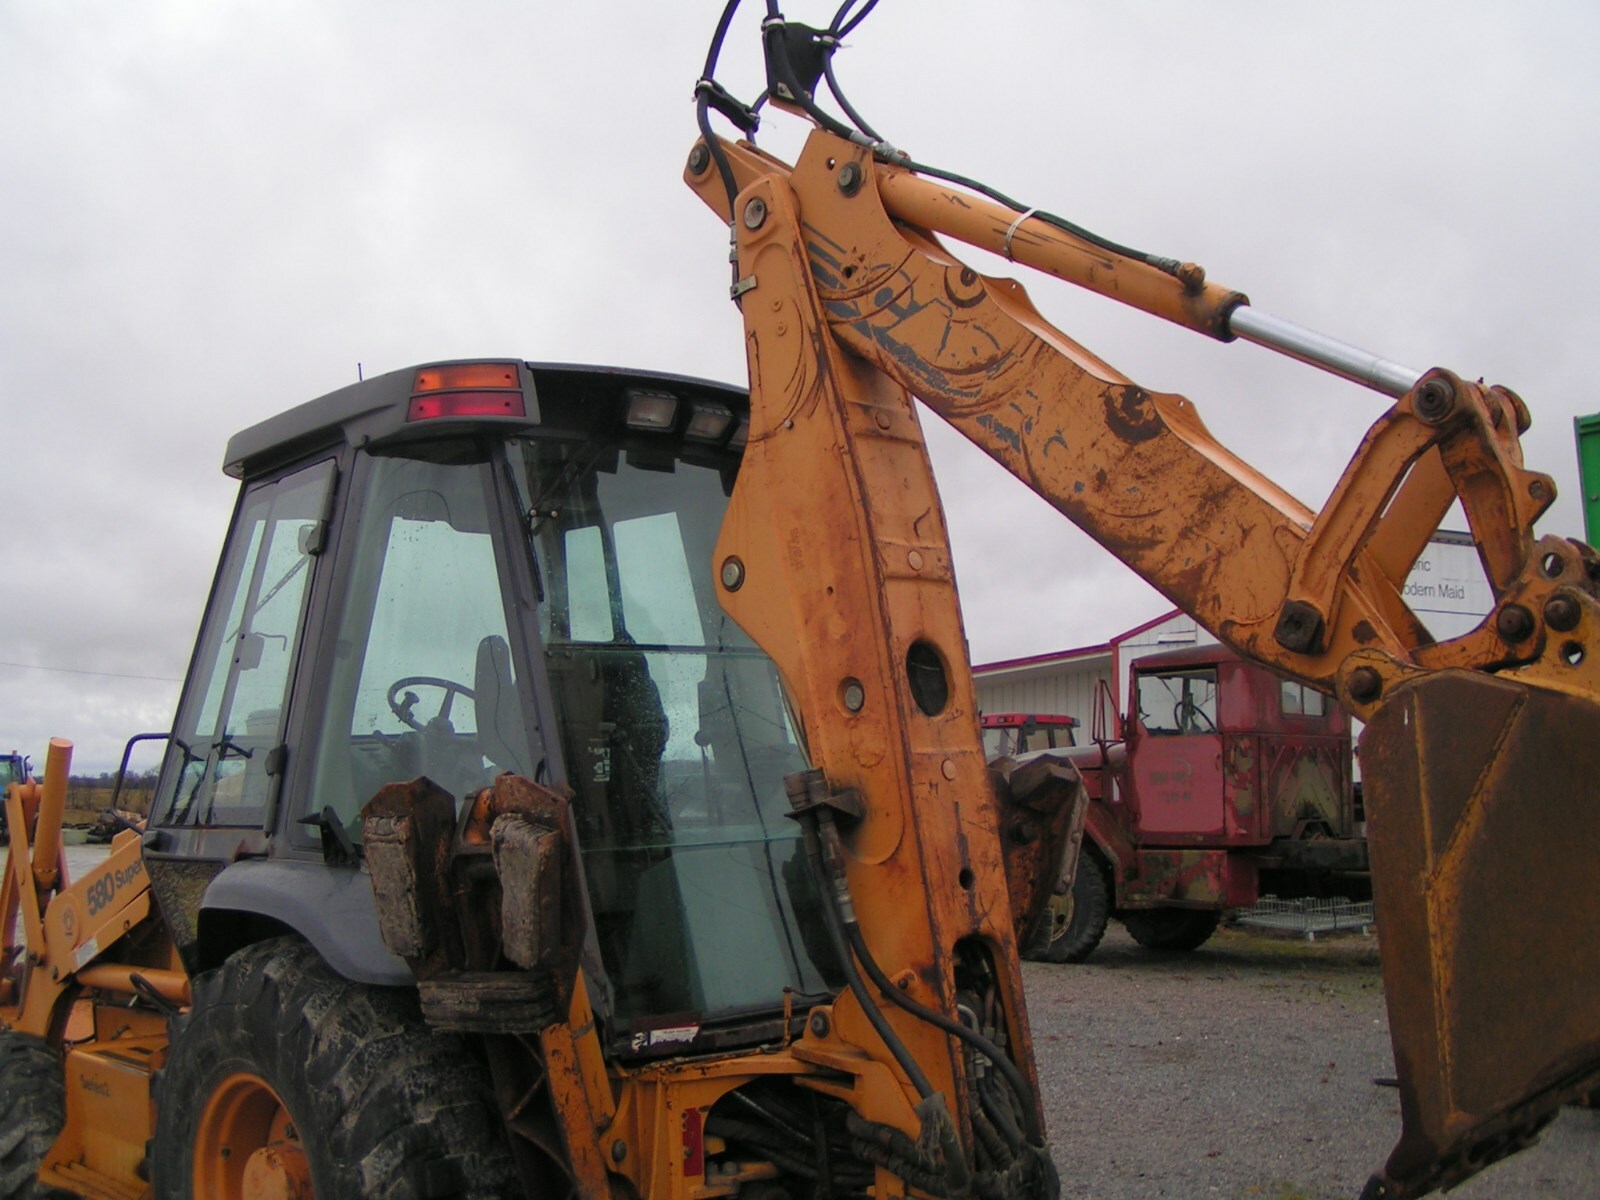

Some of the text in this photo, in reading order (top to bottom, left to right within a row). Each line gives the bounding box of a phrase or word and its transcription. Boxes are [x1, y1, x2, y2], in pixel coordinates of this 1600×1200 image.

[1403, 582, 1464, 599] odern Maid
[88, 859, 143, 916] 580 Super
